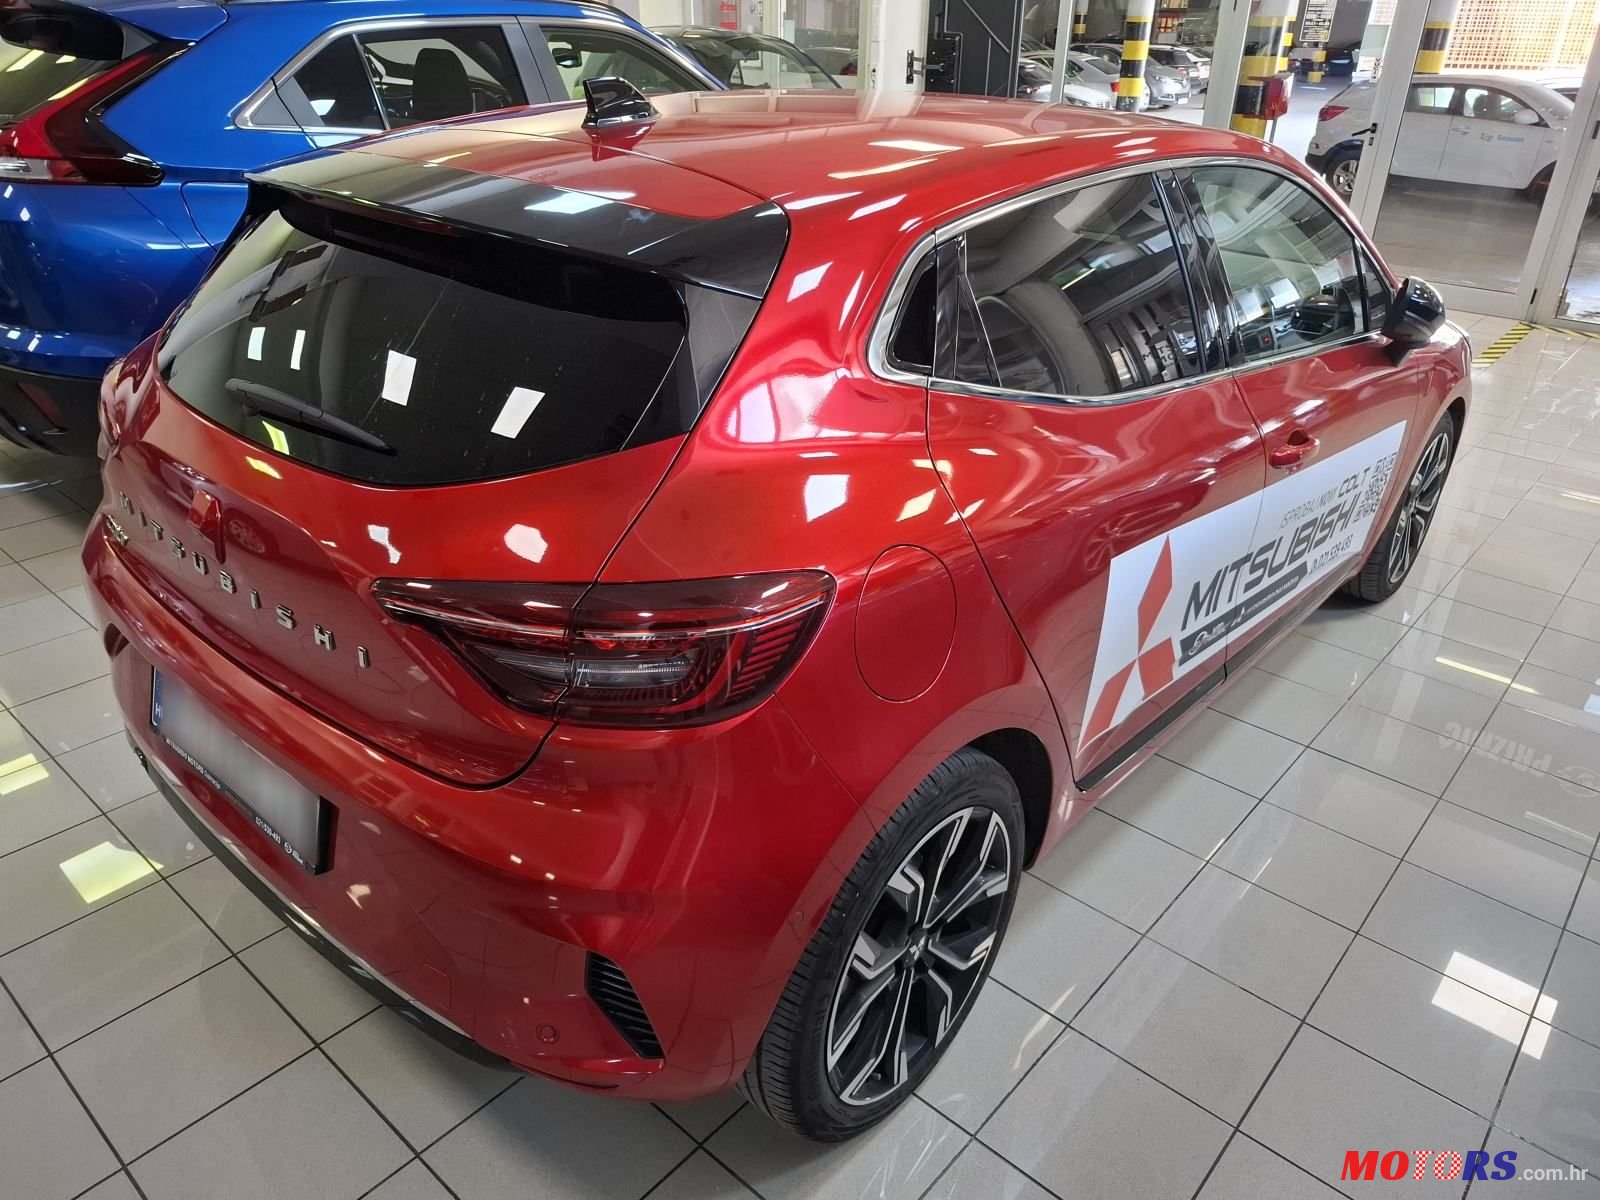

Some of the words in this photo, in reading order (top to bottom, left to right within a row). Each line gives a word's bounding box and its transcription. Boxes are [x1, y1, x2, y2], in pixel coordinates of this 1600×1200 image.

[1338, 466, 1371, 498] COLT
[119, 491, 370, 668] MITSUBISHI
[1181, 491, 1362, 632] MITSUBISHI
